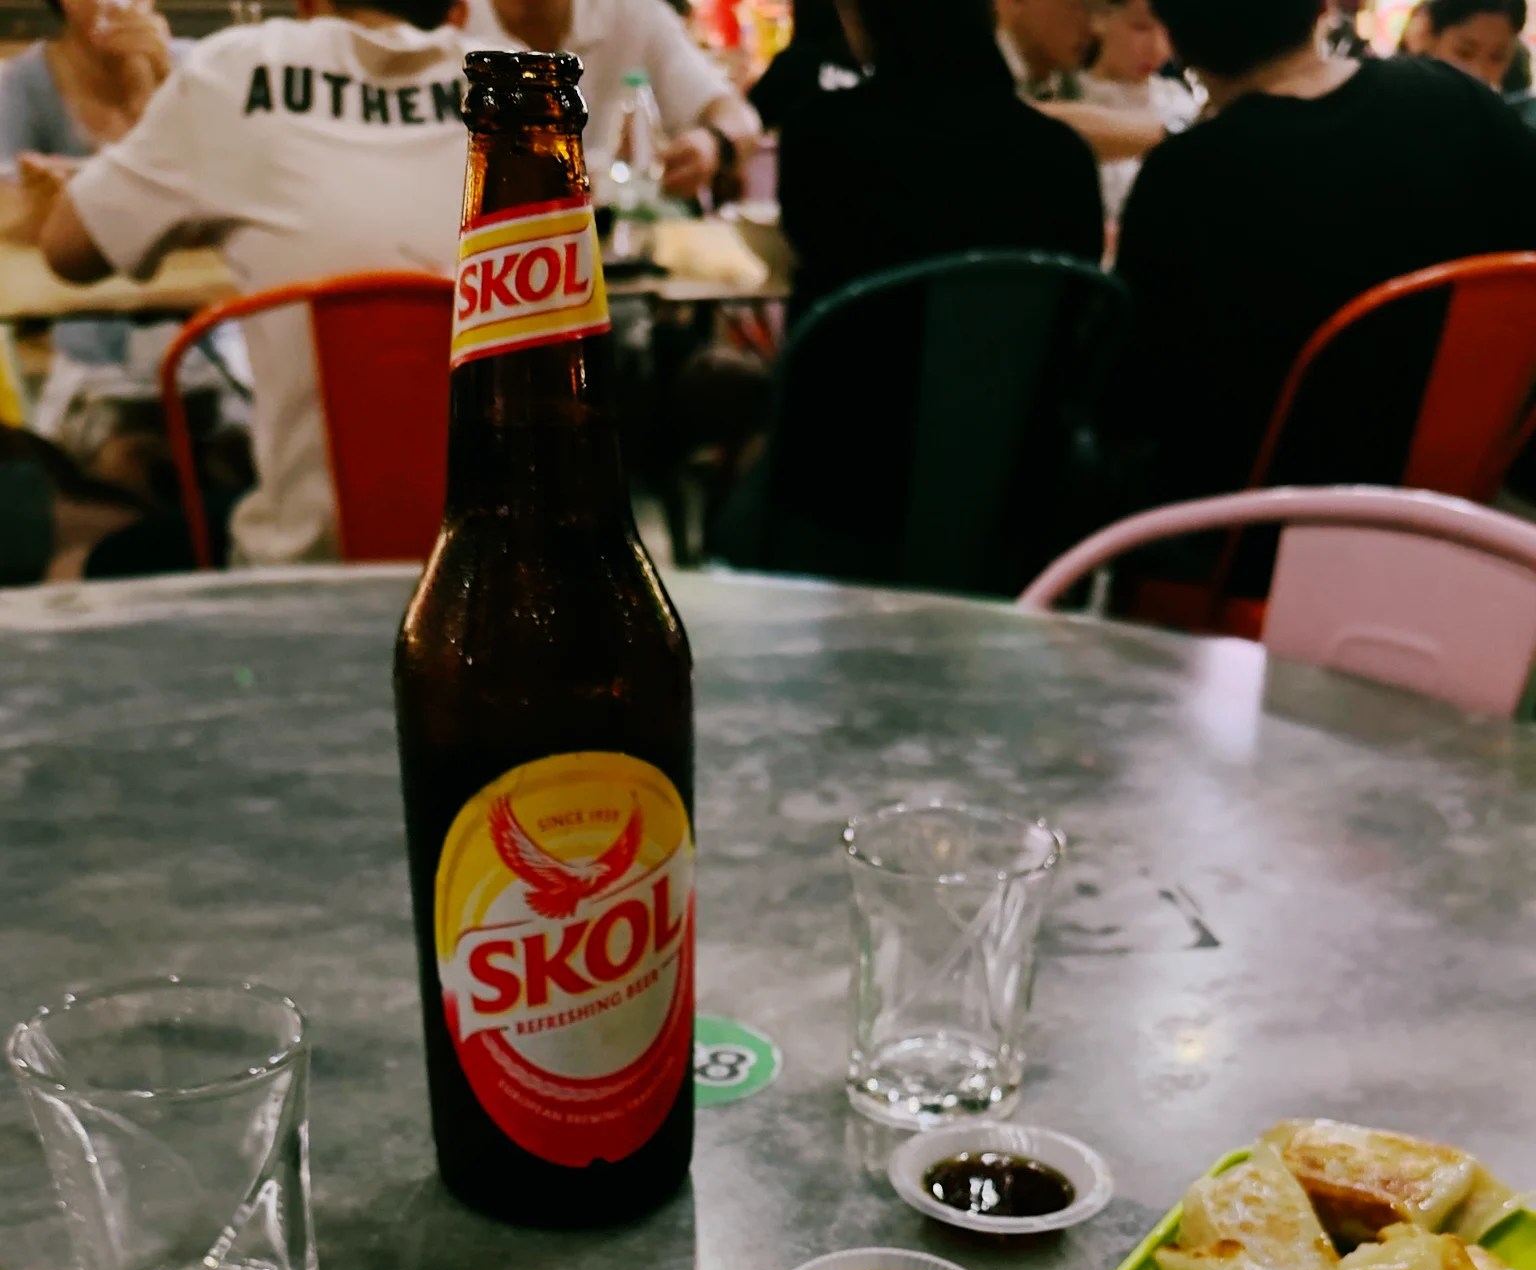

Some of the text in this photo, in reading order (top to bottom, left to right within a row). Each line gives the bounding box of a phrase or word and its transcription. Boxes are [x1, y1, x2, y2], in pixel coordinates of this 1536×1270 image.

[457, 242, 589, 321] SKOL
[537, 810, 583, 832] SINCE
[468, 877, 682, 1014] SKOL
[515, 968, 660, 1036] REFRESHING BEER
